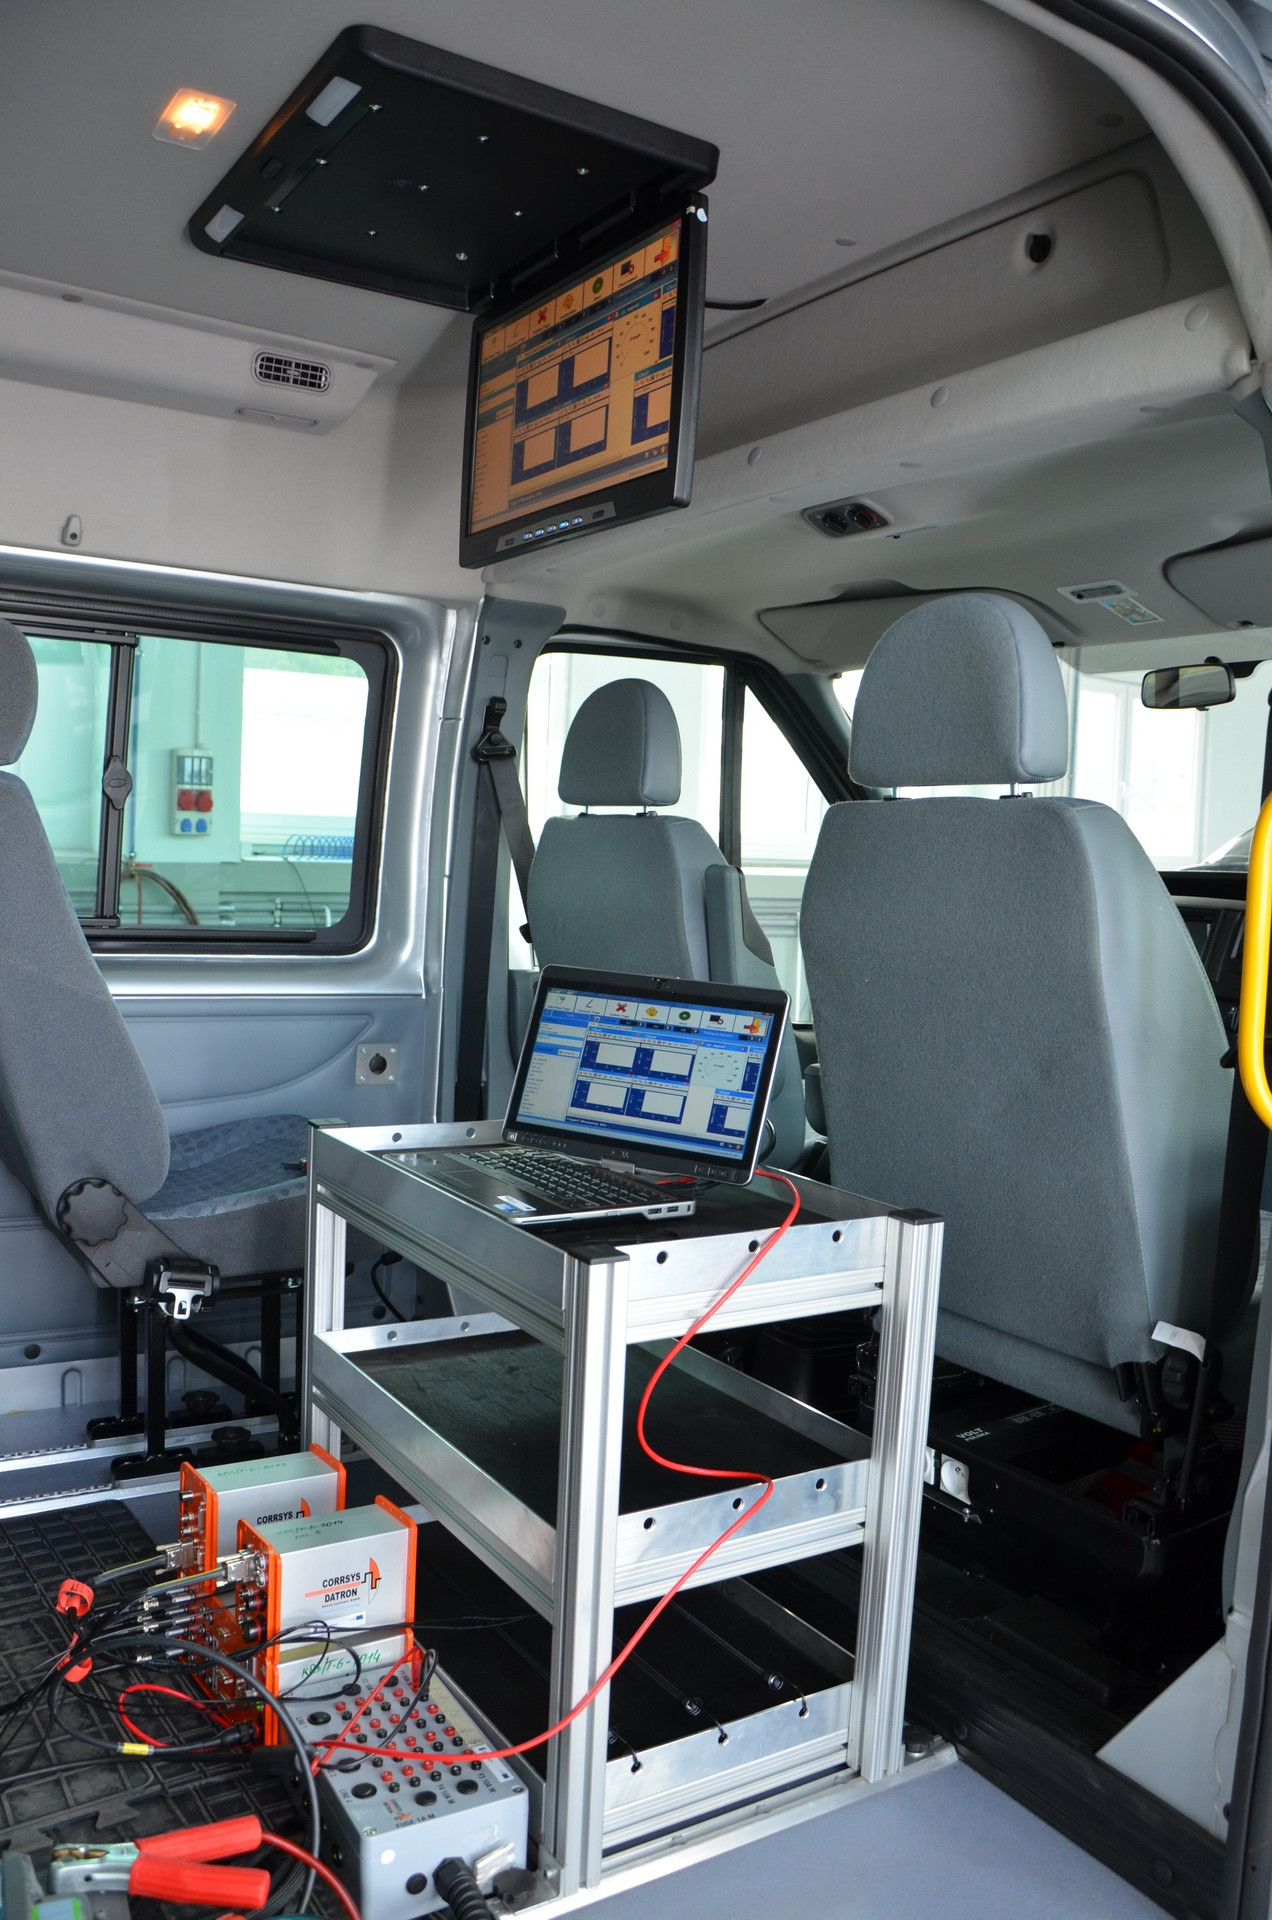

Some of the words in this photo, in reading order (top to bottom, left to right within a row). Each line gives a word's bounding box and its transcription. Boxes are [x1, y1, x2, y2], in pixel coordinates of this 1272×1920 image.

[956, 1427, 984, 1439] VOLT
[257, 1511, 293, 1525] CORRSYS
[322, 1572, 361, 1588] CORRSYS
[324, 1588, 358, 1603] DATRON
